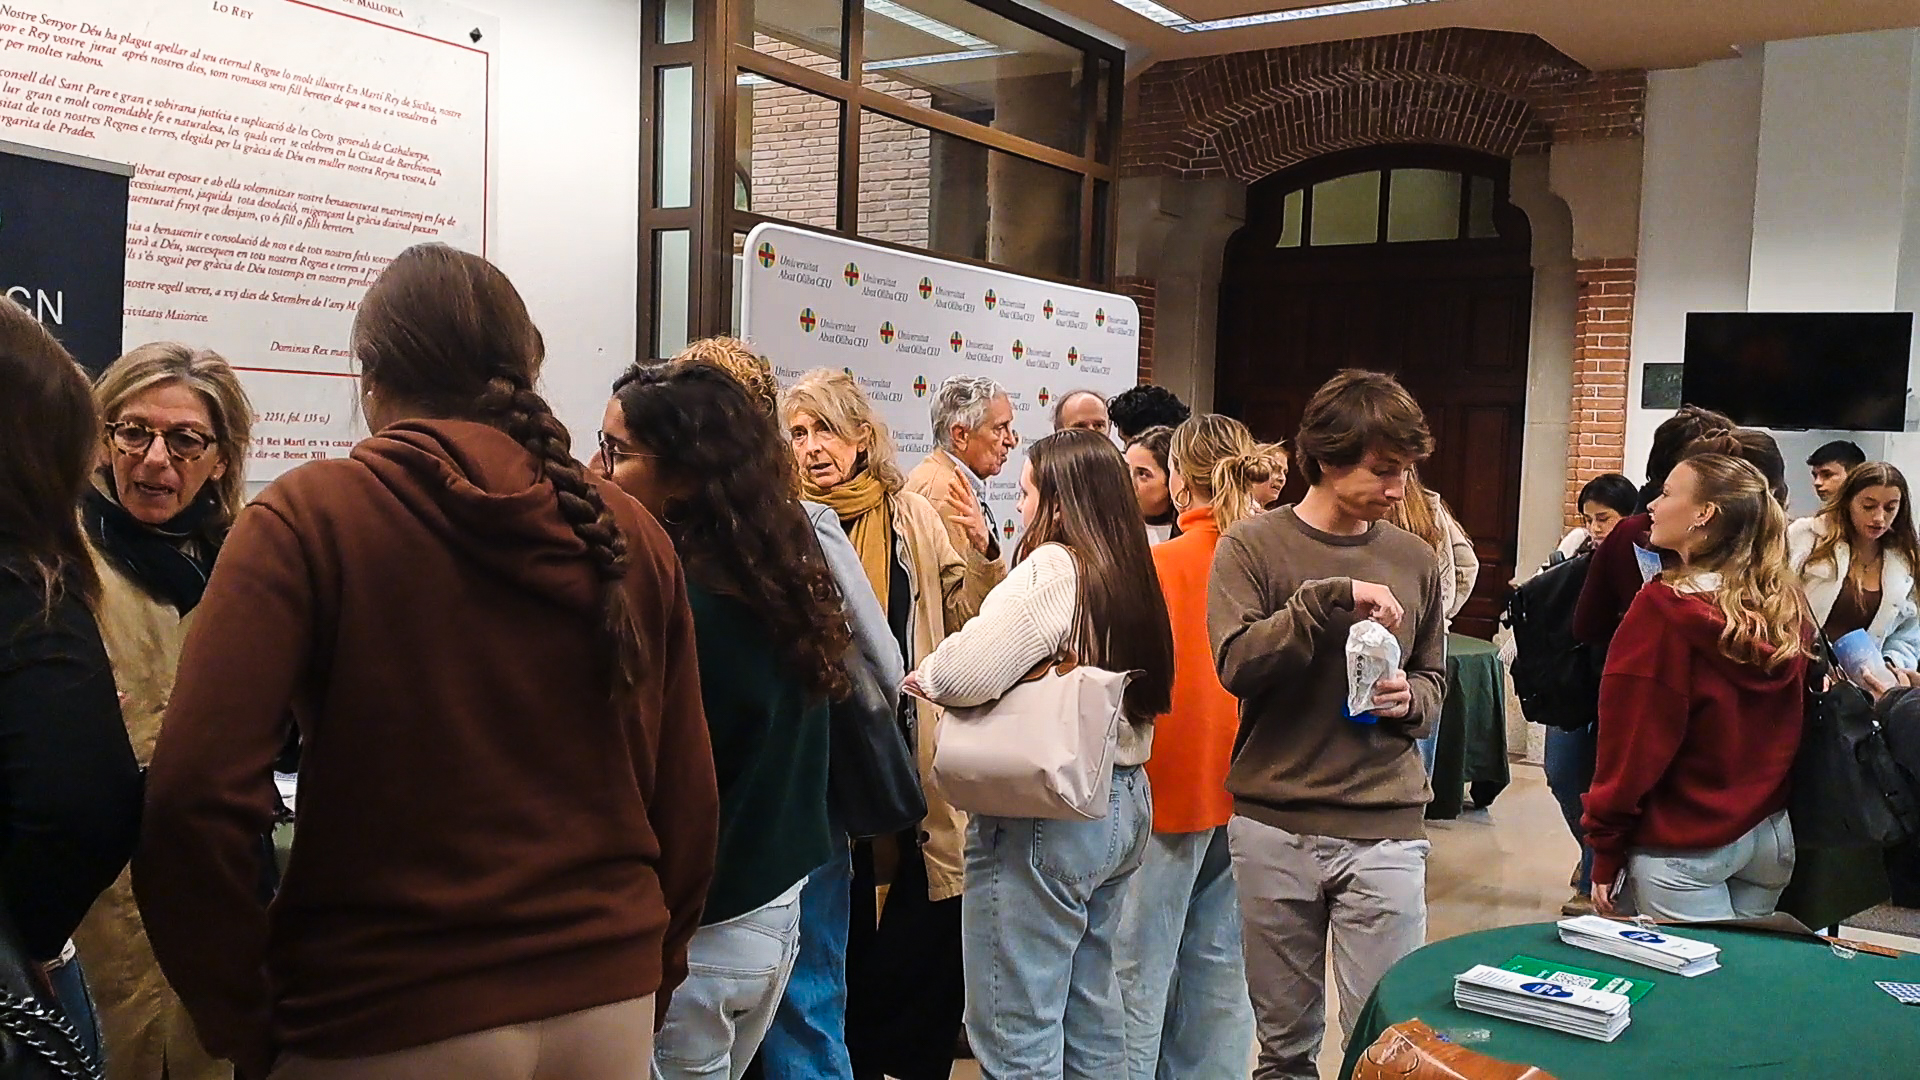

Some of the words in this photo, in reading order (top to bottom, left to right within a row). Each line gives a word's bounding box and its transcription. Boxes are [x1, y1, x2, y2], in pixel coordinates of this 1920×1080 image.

[213, 2, 228, 14] LO
[231, 7, 253, 20] REY
[1, 5, 37, 22] Nostre
[39, 14, 77, 32] Senyor
[80, 23, 102, 37] Déu
[119, 33, 152, 49] plagut
[154, 43, 188, 56] apellar
[219, 57, 252, 71] eternal
[253, 62, 280, 78] Regne
[292, 73, 314, 84] molt
[4, 38, 24, 49] per
[27, 42, 62, 57] moltes
[28, 26, 50, 43] Rey
[53, 35, 85, 48] vostre
[89, 40, 116, 55] jurat
[122, 50, 148, 62] aprés
[150, 57, 184, 70] nostres
[186, 61, 206, 77] dies,
[287, 83, 301, 97] fill
[39, 73, 57, 87] del
[58, 78, 83, 92] Sant
[86, 83, 109, 97] Pare
[120, 93, 144, 104] gran
[154, 99, 197, 114] sobirana
[197, 106, 232, 121] justícia
[241, 116, 285, 132] suplicació
[311, 128, 334, 141] Corts
[3, 80, 20, 93] lur
[26, 88, 52, 99] gran
[64, 94, 89, 106] molt
[92, 101, 152, 118] comendable
[174, 117, 225, 134] naturalesa,
[244, 130, 268, 141] quals
[270, 135, 286, 144] cert
[300, 140, 334, 154] celebren
[42, 106, 61, 117] tots
[65, 112, 100, 125] nostres
[103, 116, 138, 132] Regnes
[148, 126, 178, 141] terres,
[181, 131, 213, 146] elegida
[215, 140, 230, 150] per
[242, 143, 271, 156] gràcia
[285, 150, 303, 162] Déu
[318, 157, 346, 169] muller
[58, 121, 96, 138] Prades.
[168, 173, 202, 185] esposar
[223, 179, 241, 191] ella
[297, 194, 323, 204] nostre
[238, 195, 255, 205] tota
[257, 196, 298, 214] desolació,
[280, 213, 295, 226] fill
[302, 216, 320, 229] fills
[159, 238, 183, 253] Déu,
[249, 251, 266, 261] tots
[268, 255, 297, 264] nostres
[300, 255, 329, 270] Regnes
[211, 233, 258, 245] consolació
[307, 244, 322, 254] tots
[324, 248, 352, 258] nostres
[156, 254, 185, 266] seguit
[203, 257, 232, 270] gràcia
[247, 261, 266, 273] Déu
[267, 265, 304, 280] tostemps
[318, 273, 346, 282] nostres
[780, 255, 818, 272] Universitat
[778, 270, 795, 282] Abat
[796, 274, 814, 284] Oliba
[816, 278, 832, 289] CEU
[863, 272, 897, 287] Universitat
[124, 279, 155, 289] nostre
[157, 280, 182, 294] segell
[185, 285, 213, 296] secret,
[240, 287, 257, 299] dies
[271, 291, 314, 305] Setembre
[323, 296, 344, 311] l'any
[861, 287, 876, 298] Abat
[877, 290, 893, 300] Oliba
[894, 293, 909, 302] CEU
[935, 286, 965, 299] Universitat
[934, 299, 948, 309] Abat
[820, 318, 856, 332] Universitat
[818, 332, 834, 342] Abat
[835, 335, 852, 345] Oliba
[853, 338, 868, 347] CEU
[898, 330, 929, 342] Universitat
[896, 343, 910, 353] Abat
[911, 346, 926, 355] Oliba
[926, 348, 940, 356] CEU
[858, 376, 891, 388] Universitat
[871, 392, 888, 401] Oliba
[889, 393, 902, 402] CEU
[892, 430, 924, 440] Universitat
[906, 444, 921, 452] Oliba
